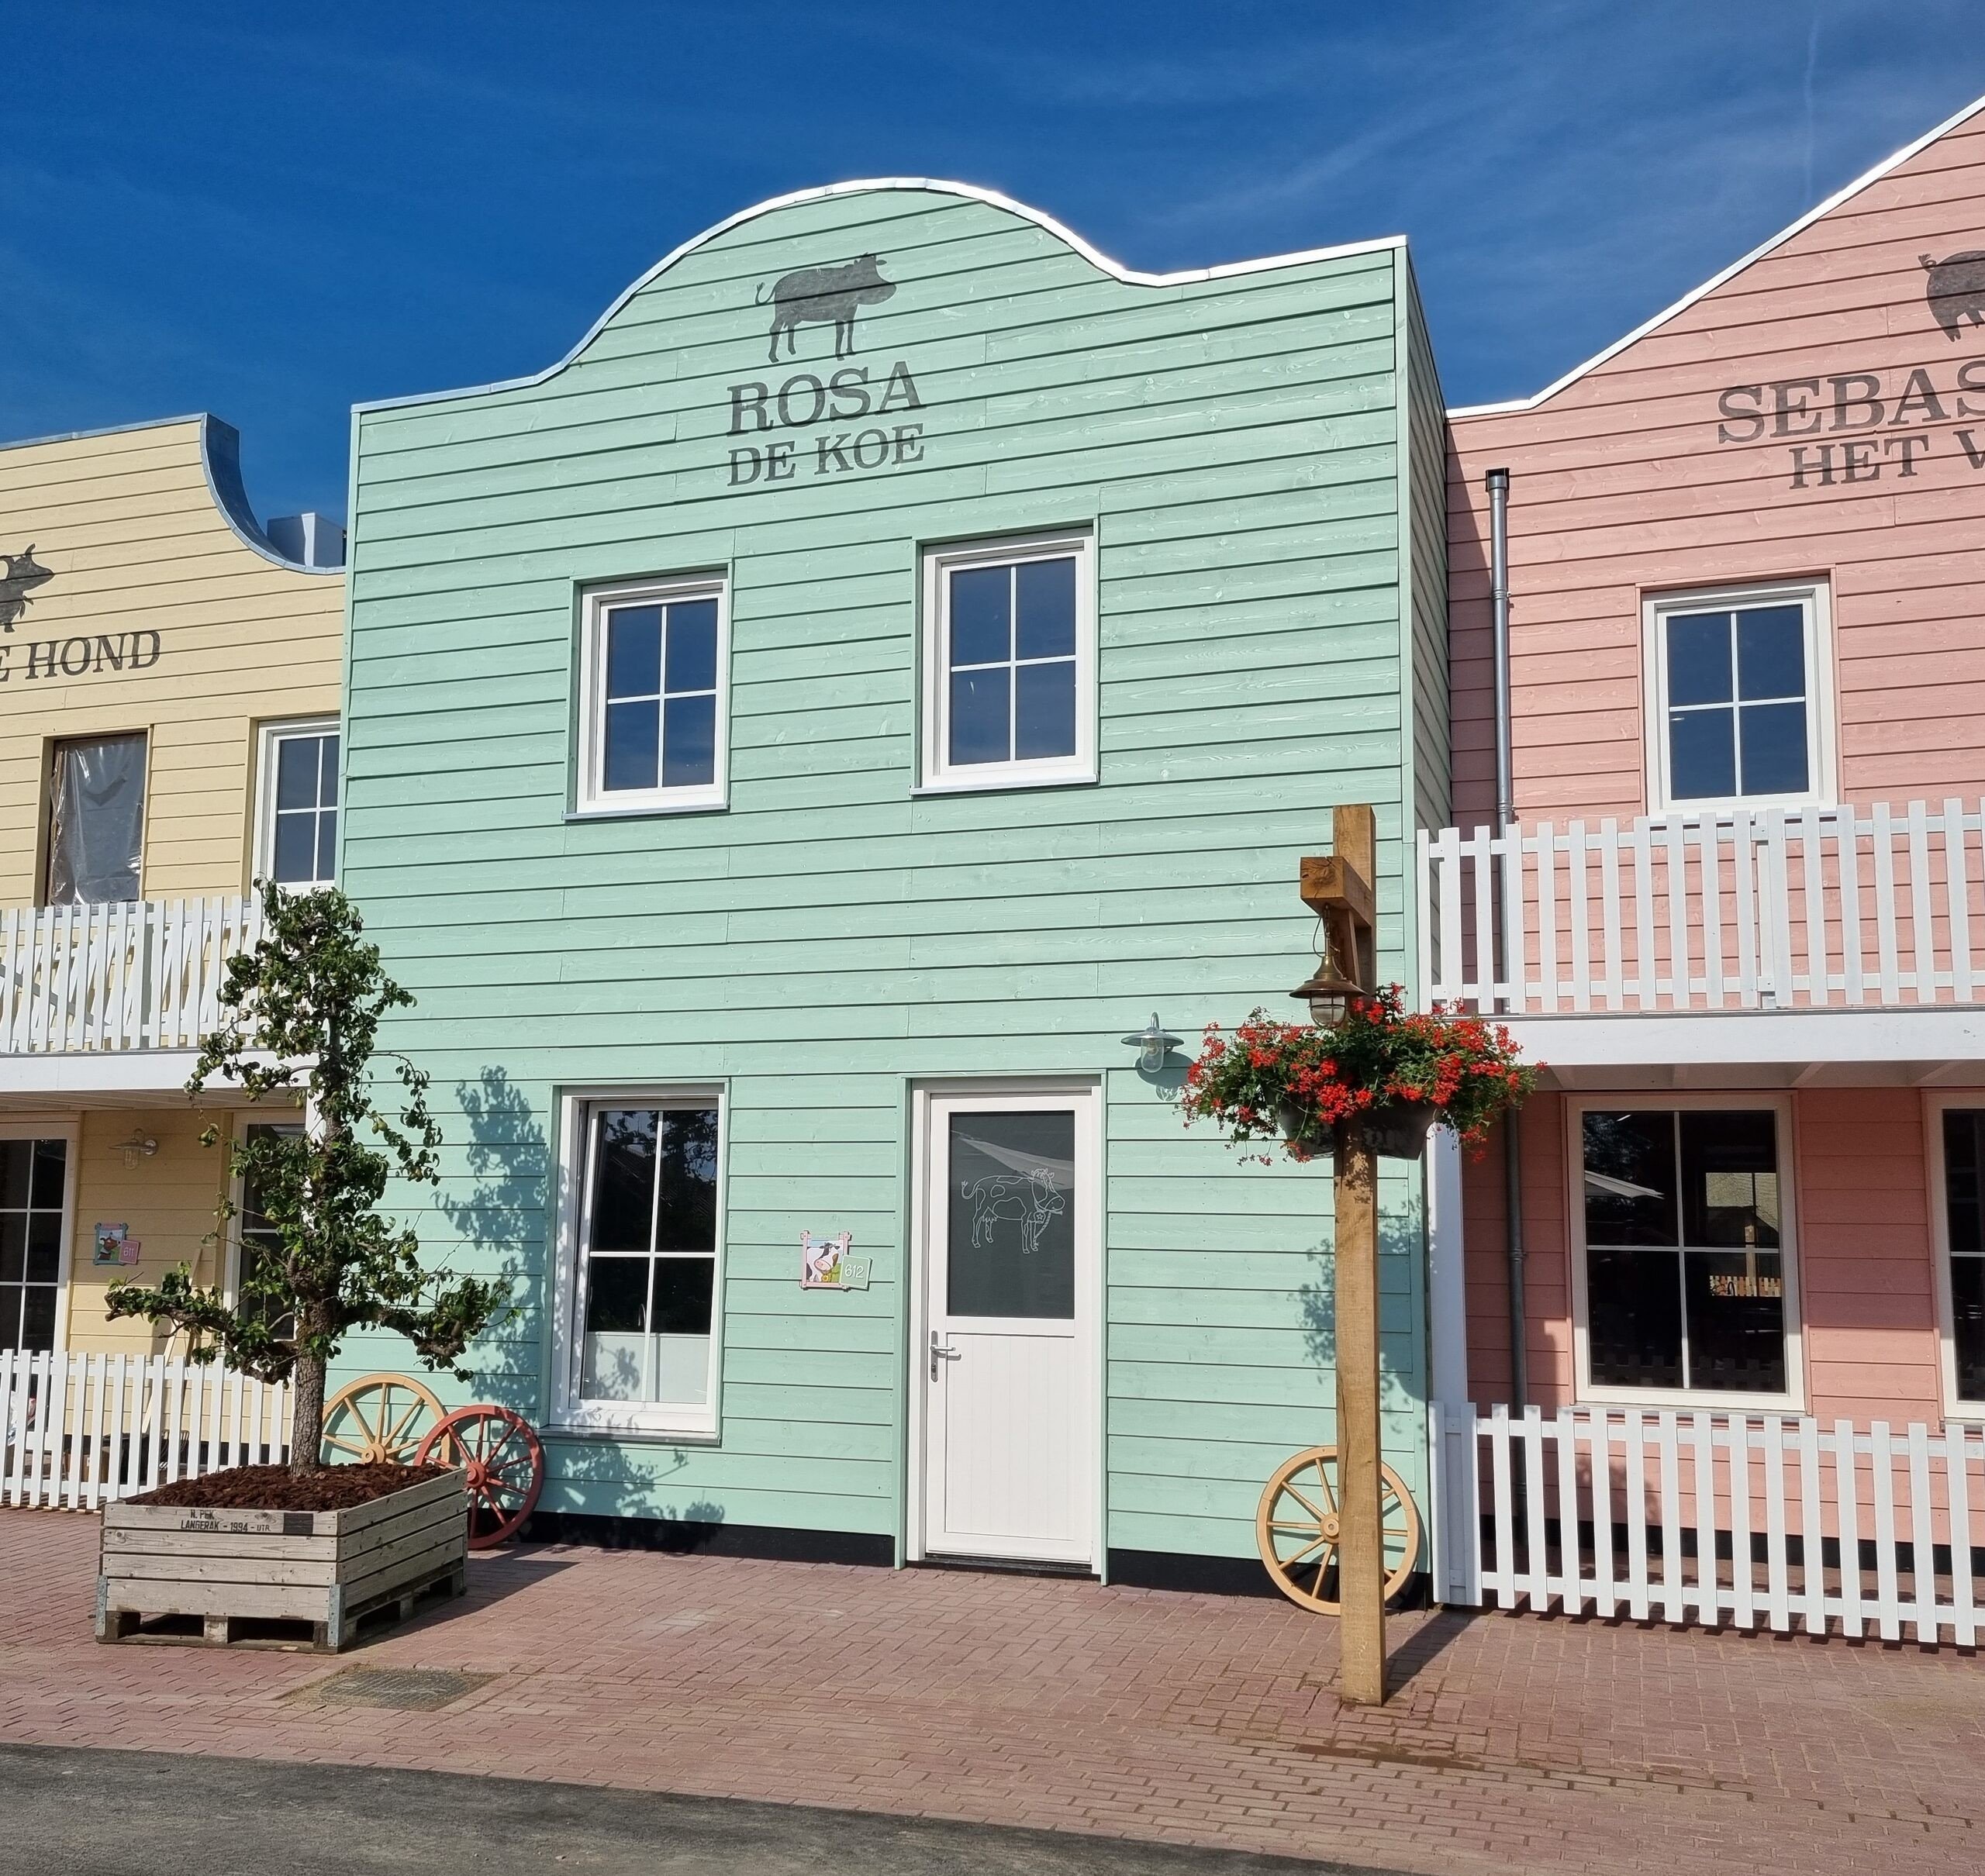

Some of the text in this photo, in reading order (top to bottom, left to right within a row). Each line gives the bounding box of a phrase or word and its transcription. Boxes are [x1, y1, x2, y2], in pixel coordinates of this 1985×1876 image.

[727, 361, 927, 437] ROSA
[1717, 360, 1985, 444] SEBAS
[727, 422, 924, 487] DE KOE
[1789, 435, 1929, 490] HET
[26, 630, 161, 680] HOND
[123, 1247, 134, 1257] 611
[844, 1264, 865, 1279] 612
[230, 1522, 248, 1533] 1994
